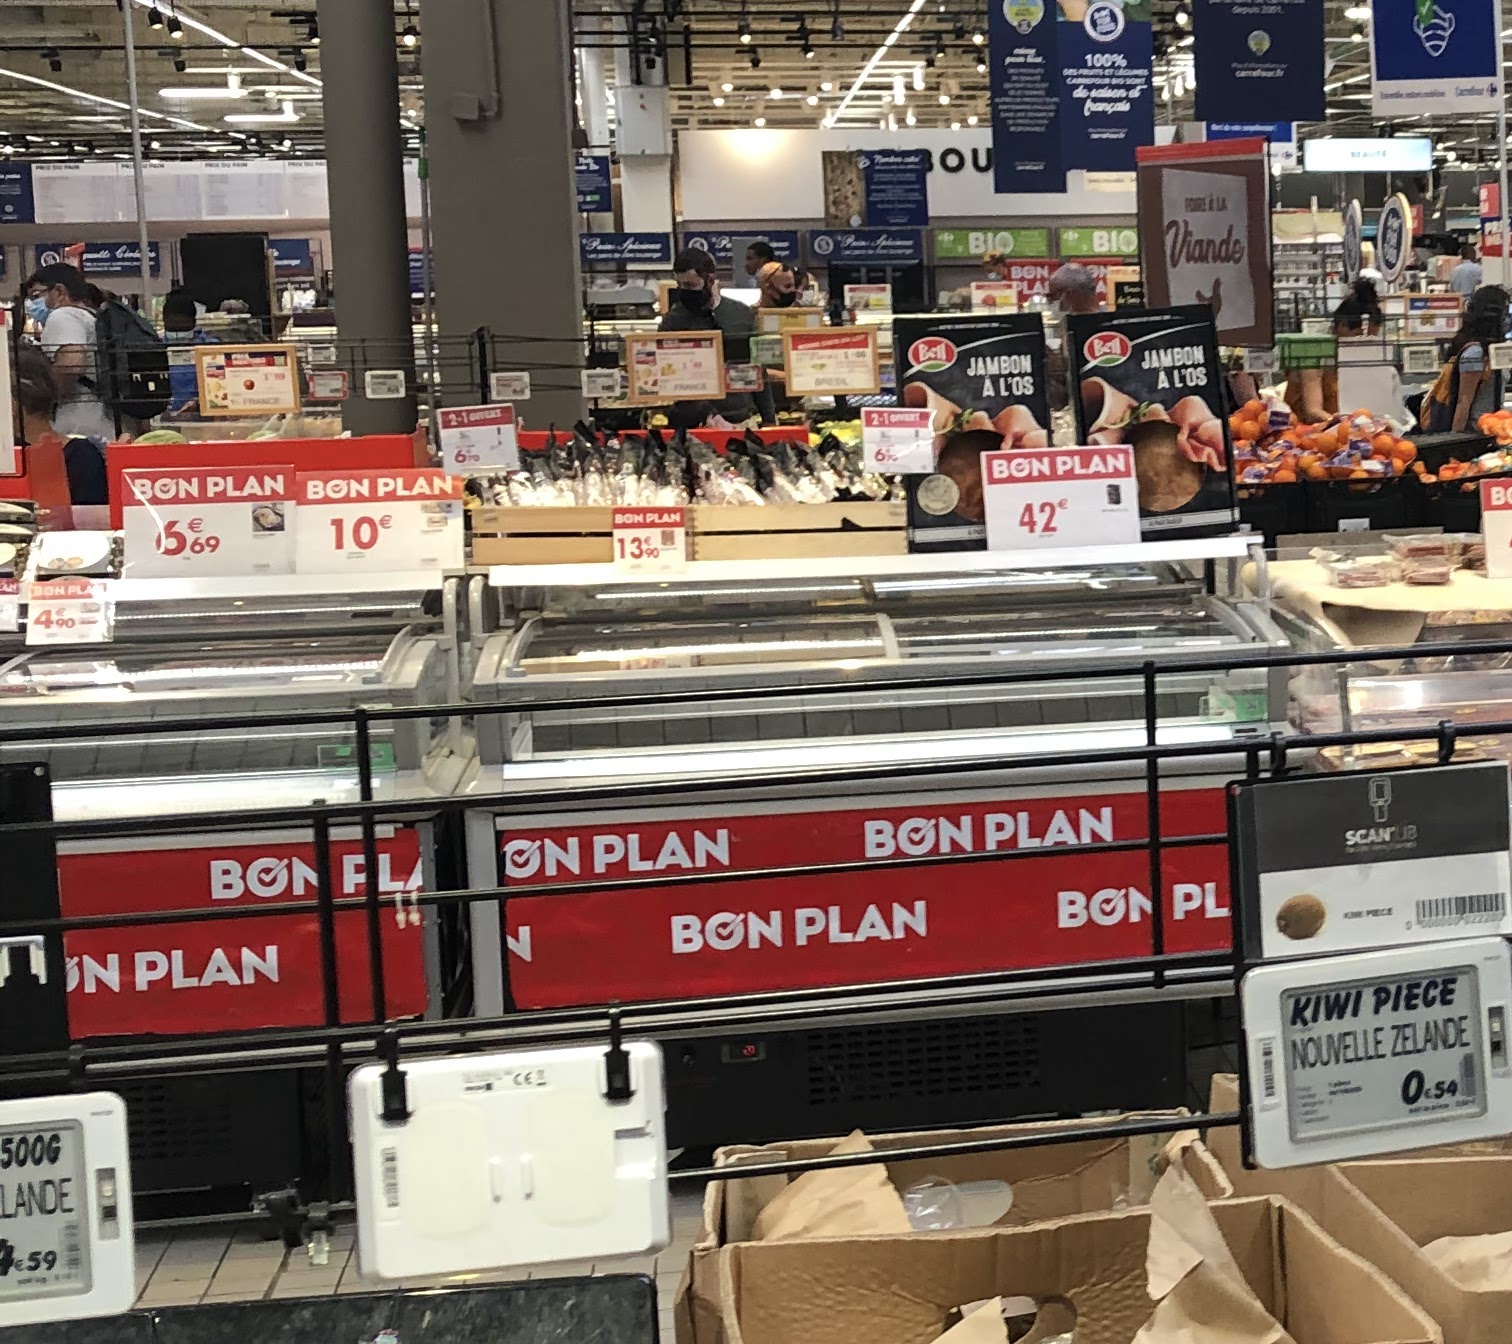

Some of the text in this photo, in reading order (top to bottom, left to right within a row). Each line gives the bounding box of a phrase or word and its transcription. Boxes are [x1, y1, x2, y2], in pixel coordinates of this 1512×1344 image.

[1084, 53, 1128, 67] 100%
[968, 231, 1015, 254] BIO
[1092, 230, 1138, 253] BIO
[1166, 219, 1245, 269] Viande
[1011, 265, 1049, 279] BON
[966, 355, 1033, 377] JAMBON
[1141, 345, 1205, 370] JAMBON
[982, 376, 1035, 397] À L'OS
[1157, 366, 1208, 389] À L'OS
[992, 453, 1126, 480] BON PLAN
[135, 475, 285, 500] BON PLAN
[306, 475, 453, 500] BON PLAN
[614, 511, 681, 525] BON PLAN
[1018, 497, 1068, 533] 42€
[330, 514, 392, 551] 10€
[33, 585, 65, 597] BON
[865, 807, 1114, 859] BON PLAN
[593, 828, 731, 875] PLAN
[209, 856, 320, 900] BON
[1058, 886, 1152, 929] BON
[671, 900, 928, 954] BON PLAN
[135, 945, 280, 992] PLAN
[1290, 976, 1459, 1029] KIWI PIECE
[1291, 1014, 1470, 1071] NOUVELLE ZELANDE
[0, 1133, 61, 1170] 500G
